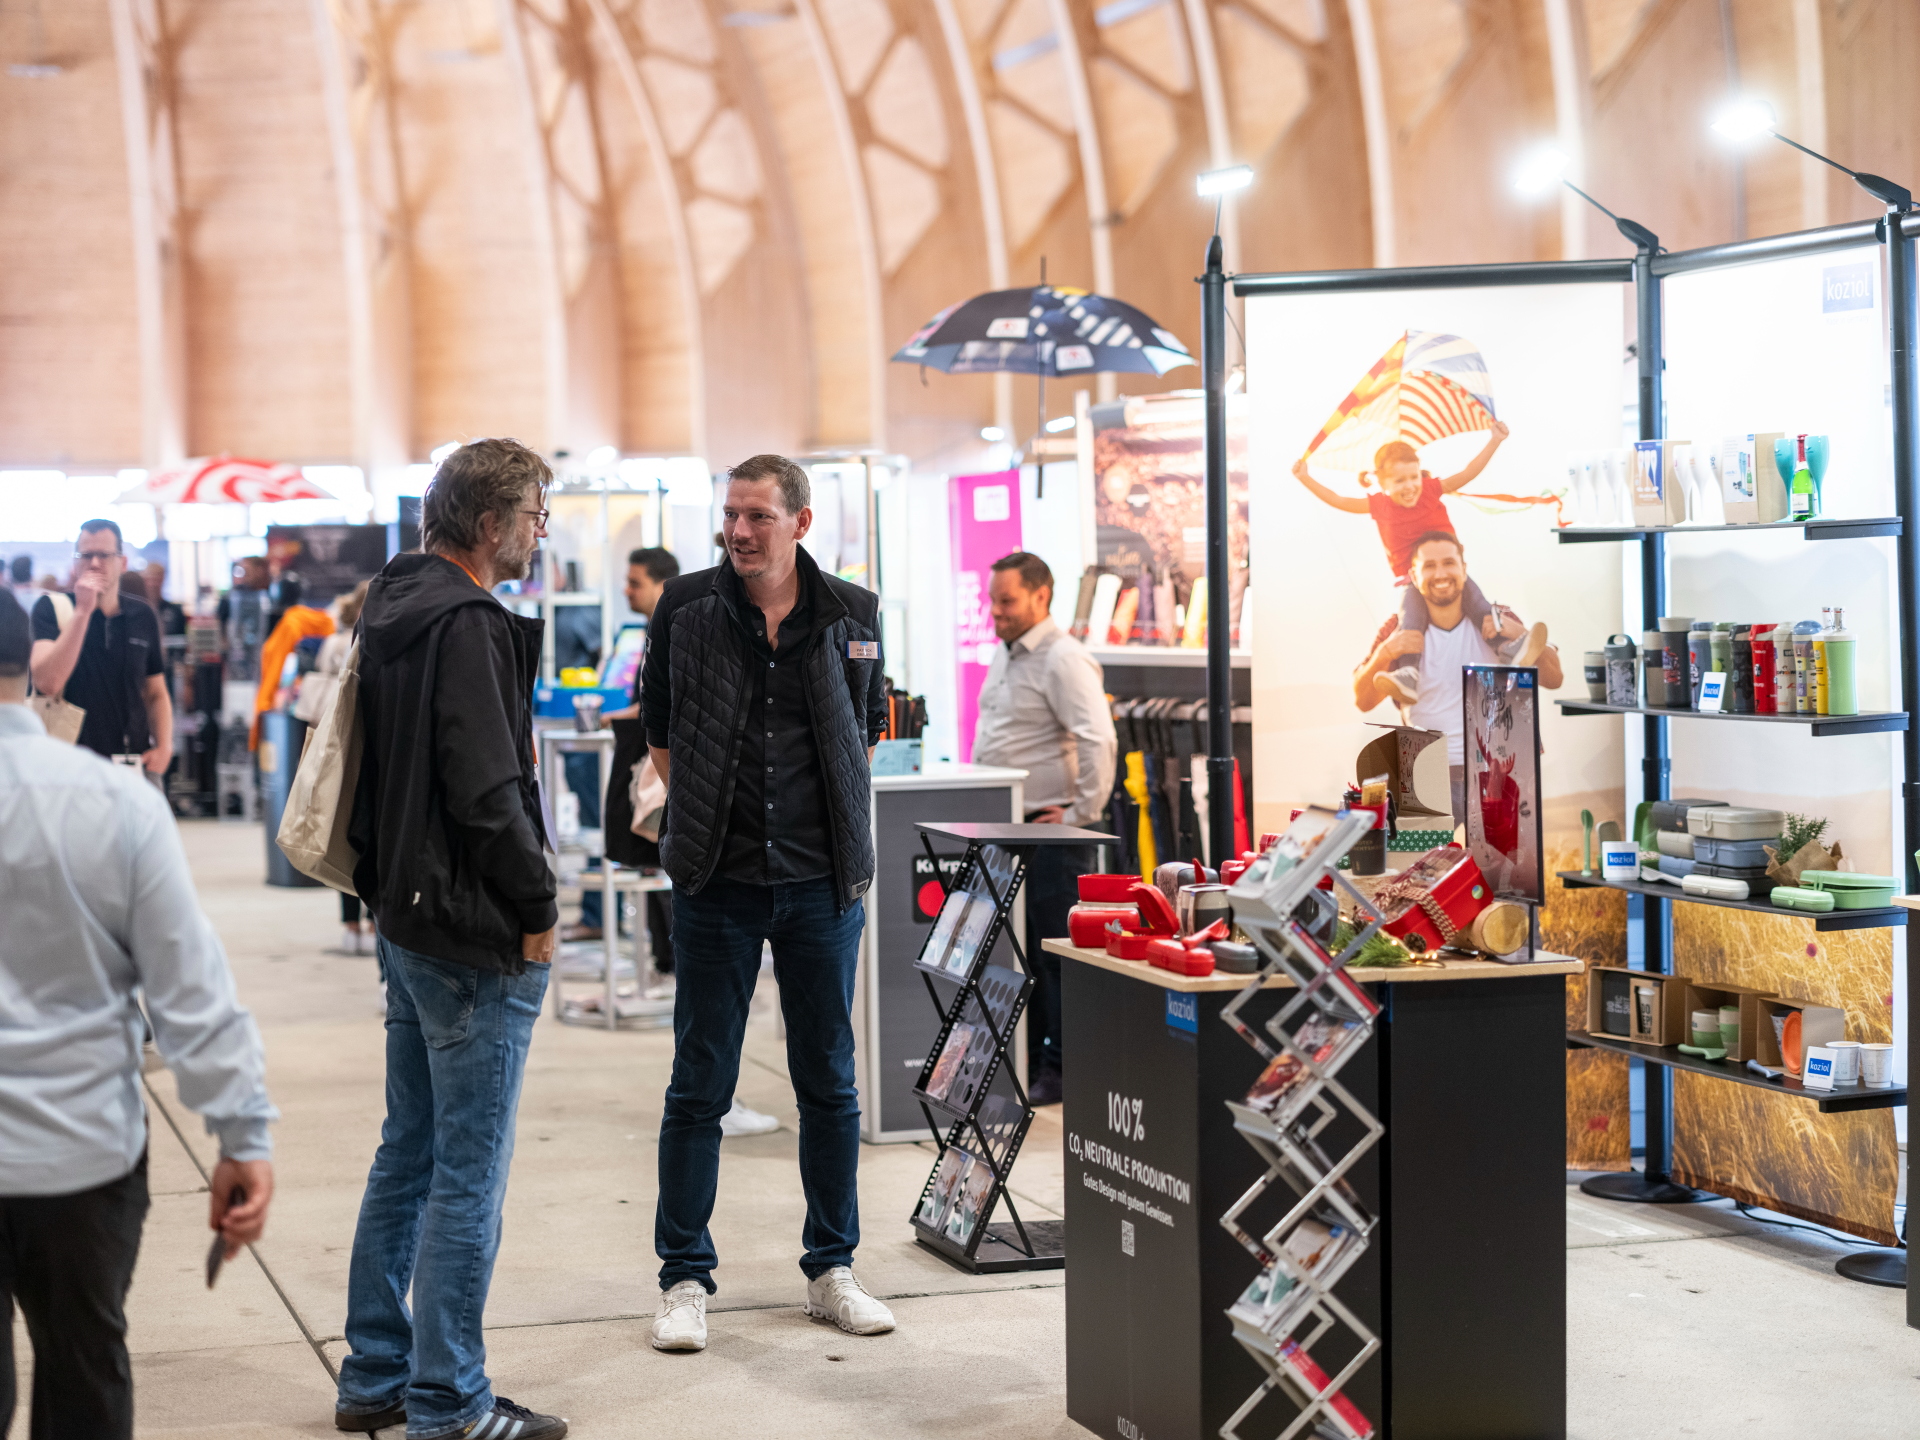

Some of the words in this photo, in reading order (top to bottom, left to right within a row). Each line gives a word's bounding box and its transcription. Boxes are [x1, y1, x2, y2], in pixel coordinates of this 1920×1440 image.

[1826, 272, 1870, 301] koziol
[1609, 854, 1634, 864] koziol
[1167, 993, 1196, 1023] koziol
[1810, 1060, 1830, 1073] koziol
[1108, 1091, 1145, 1142] 100%
[1084, 1139, 1130, 1178] NEUTRALE
[1131, 1158, 1191, 1204] PRODUKTION
[1083, 1172, 1099, 1192] Gutes
[1099, 1179, 1117, 1202] Design
[1117, 1190, 1127, 1206] mit
[1127, 1195, 1145, 1214] gutem
[1145, 1201, 1175, 1228] Gewissen.
